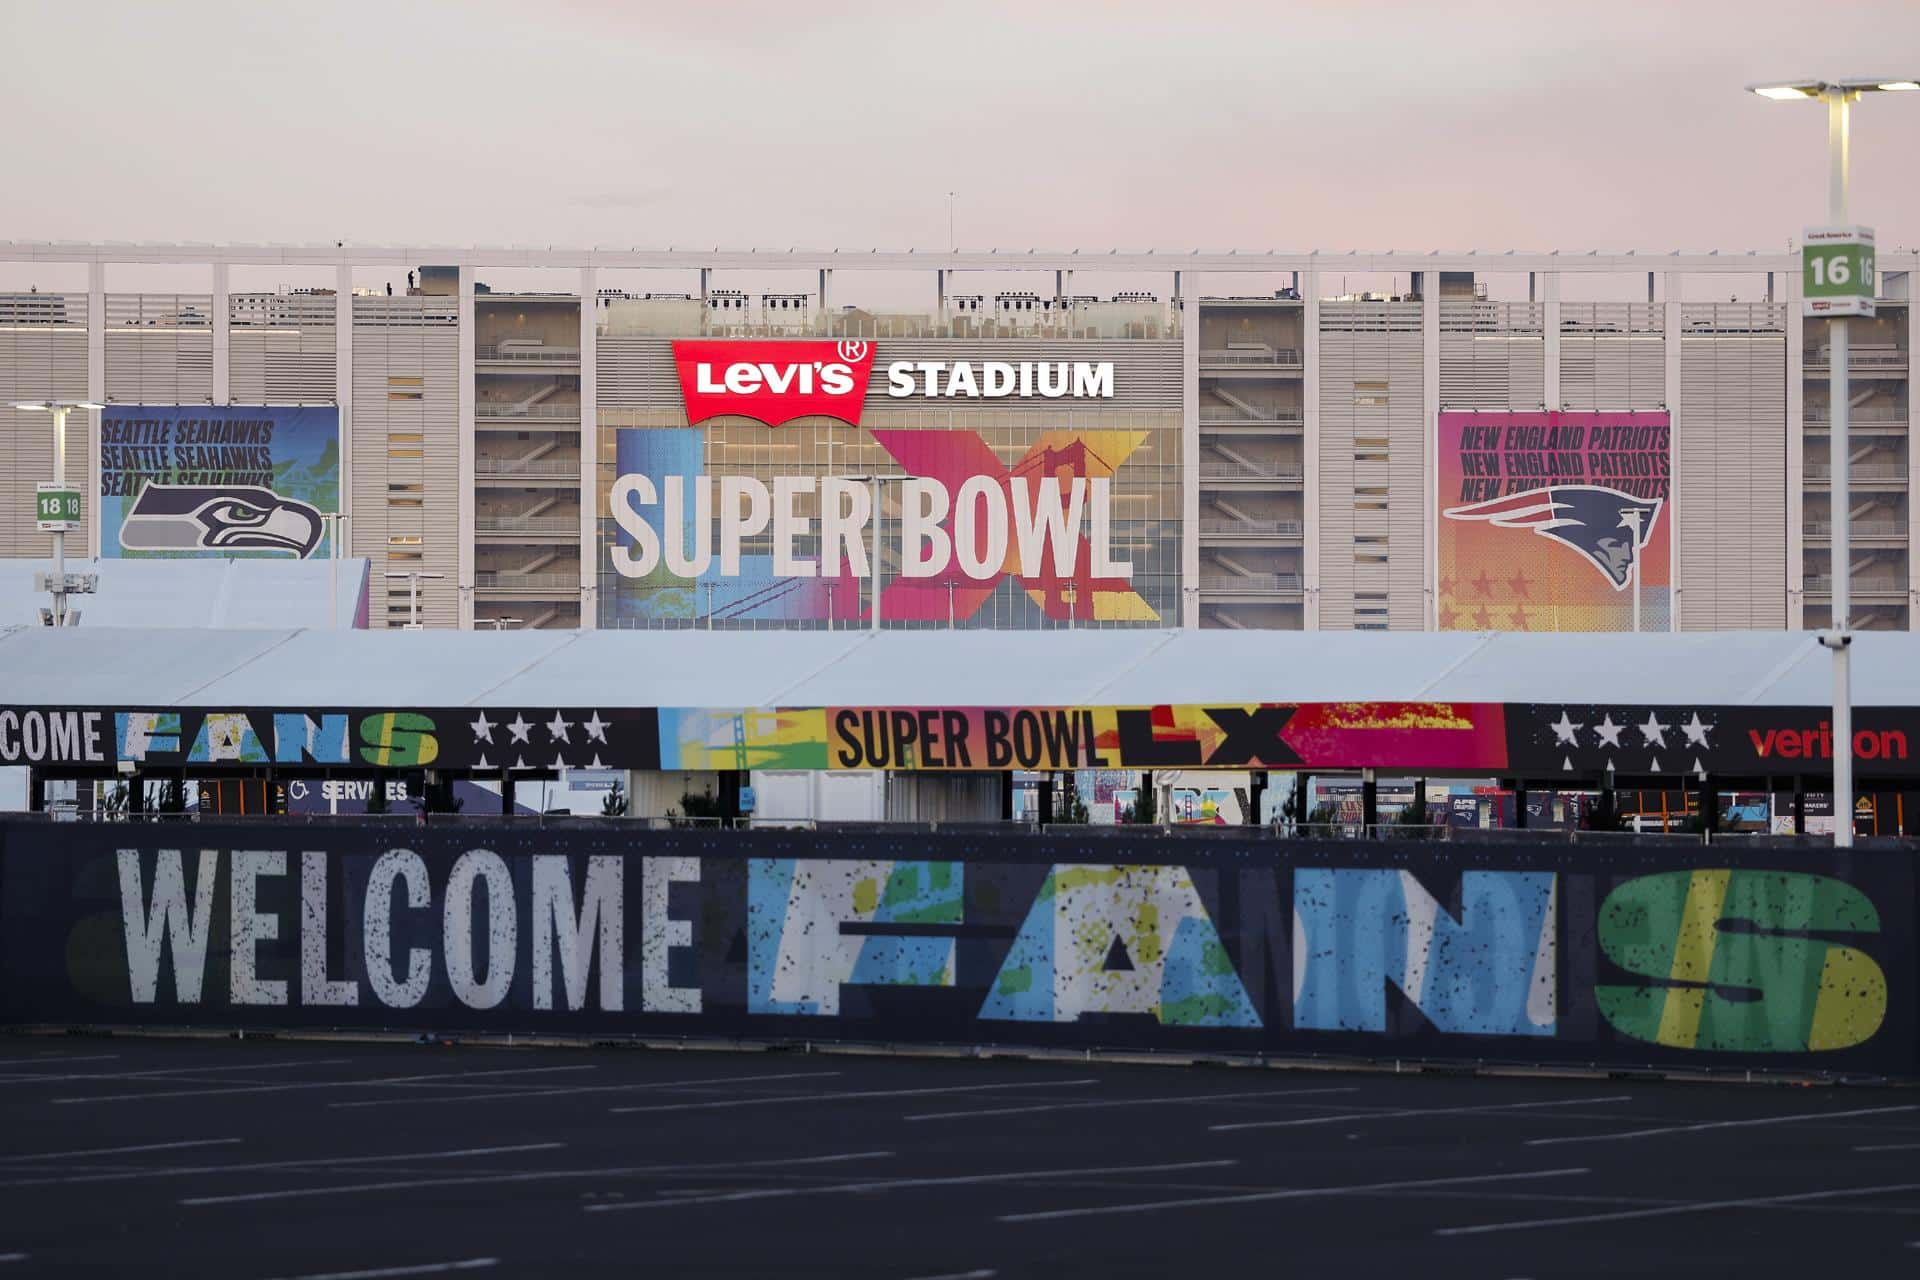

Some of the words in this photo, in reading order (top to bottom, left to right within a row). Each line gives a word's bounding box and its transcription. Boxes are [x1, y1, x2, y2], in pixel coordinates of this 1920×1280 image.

[1811, 256, 1850, 286] 16
[1860, 256, 1873, 286] 16
[887, 360, 1115, 398] STADIUM
[100, 419, 172, 443] SEATTLE
[174, 419, 274, 443] SEAHAWKS
[1459, 426, 1502, 450] NEW
[1504, 426, 1585, 450] ENGLAND
[1588, 426, 1670, 450] PATRIOTS
[100, 446, 172, 470] SEATTLE
[174, 446, 273, 470] SEAHAWKS
[1459, 452, 1501, 476] NEW
[1504, 452, 1585, 476] ENGLAND
[1588, 452, 1670, 476] PATRIOTS
[41, 498, 61, 514] 18
[67, 498, 79, 514] 18
[609, 472, 872, 579] SUPER
[901, 474, 1135, 580] BOWL
[114, 712, 439, 767] FANS
[835, 709, 970, 768] SUPER
[984, 709, 1109, 768] BOWL
[1117, 708, 1306, 767] LX
[1749, 721, 1908, 759] verion
[321, 780, 408, 801] SERVIES
[116, 848, 703, 1014] WELCOME
[747, 857, 1888, 1053] FANS
